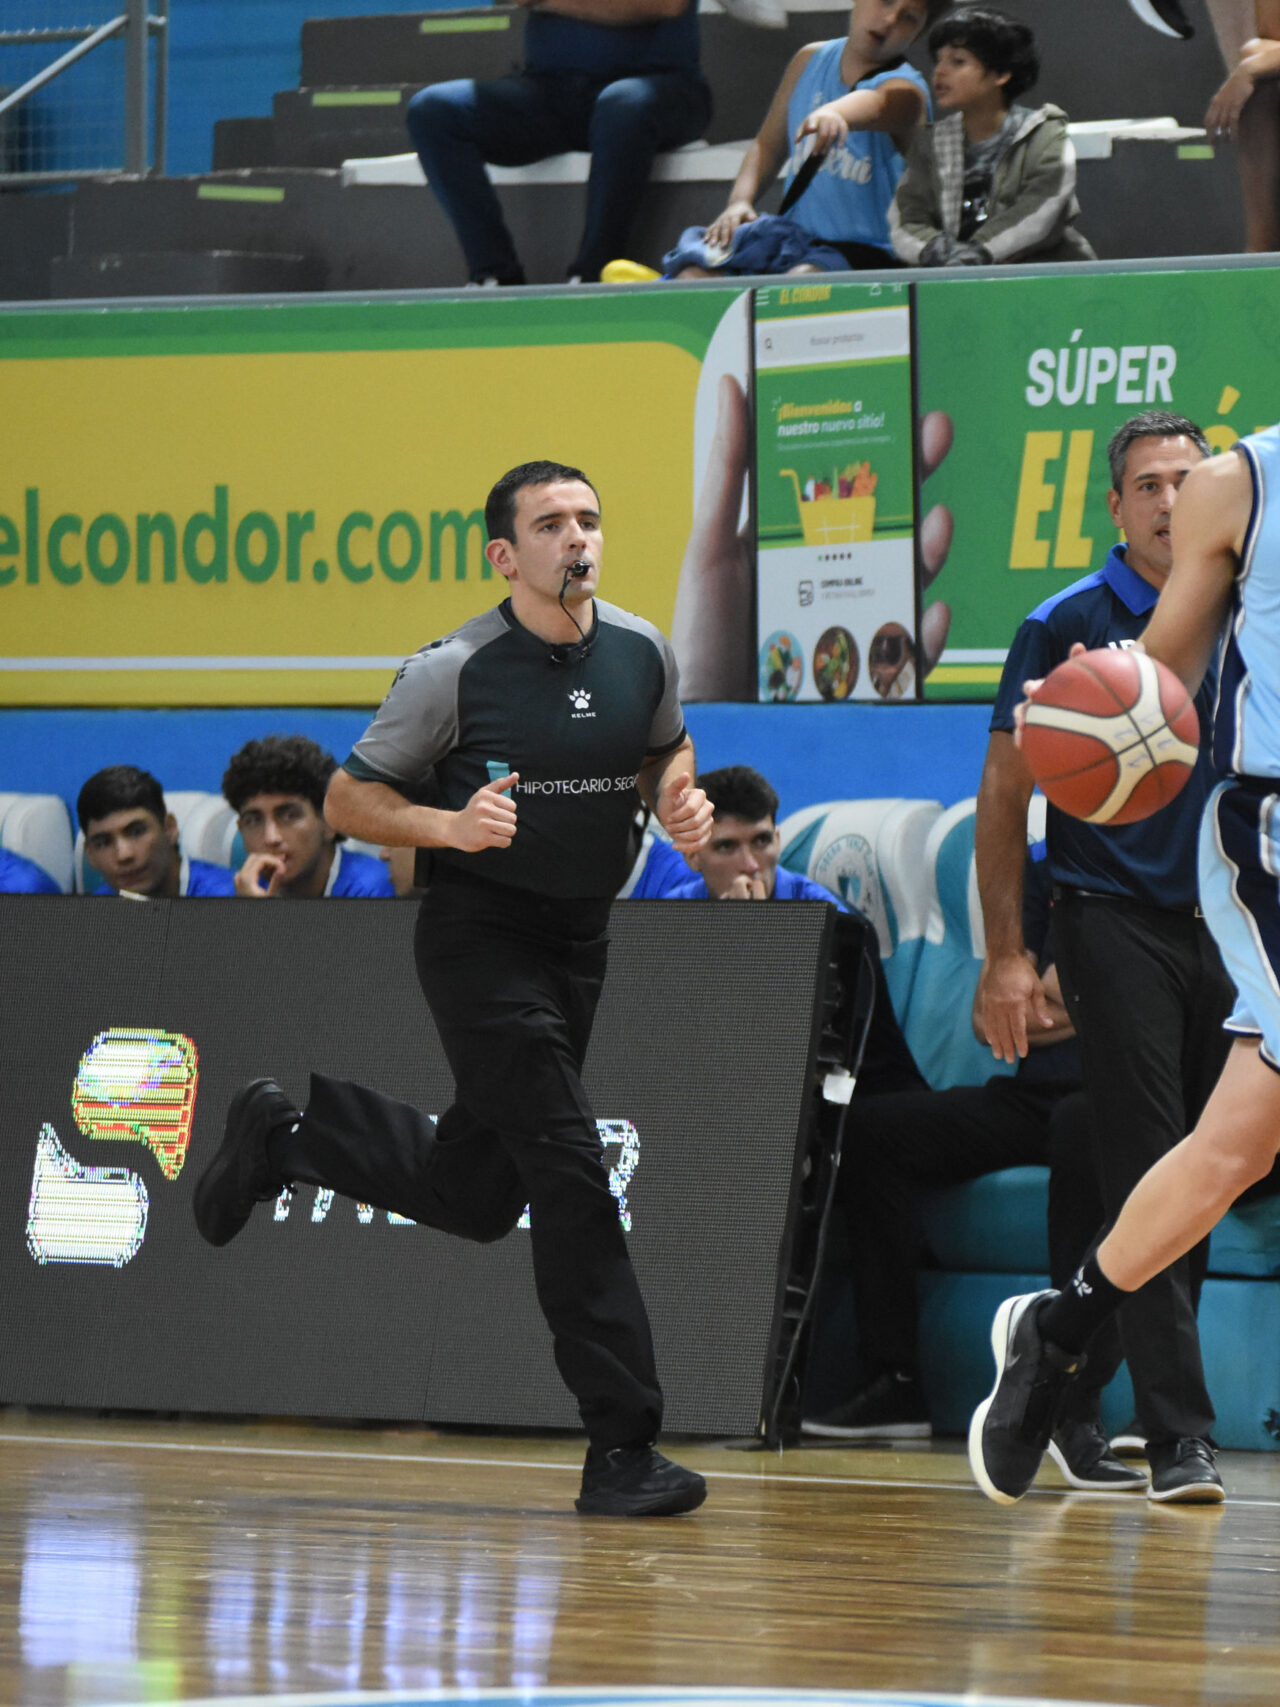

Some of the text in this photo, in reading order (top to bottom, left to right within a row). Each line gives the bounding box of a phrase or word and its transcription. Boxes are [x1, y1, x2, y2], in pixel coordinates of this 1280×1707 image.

[1025, 328, 1177, 406] SÚPER
[1009, 430, 1094, 569] EL
[516, 777, 612, 795] HIPOTECARIO
